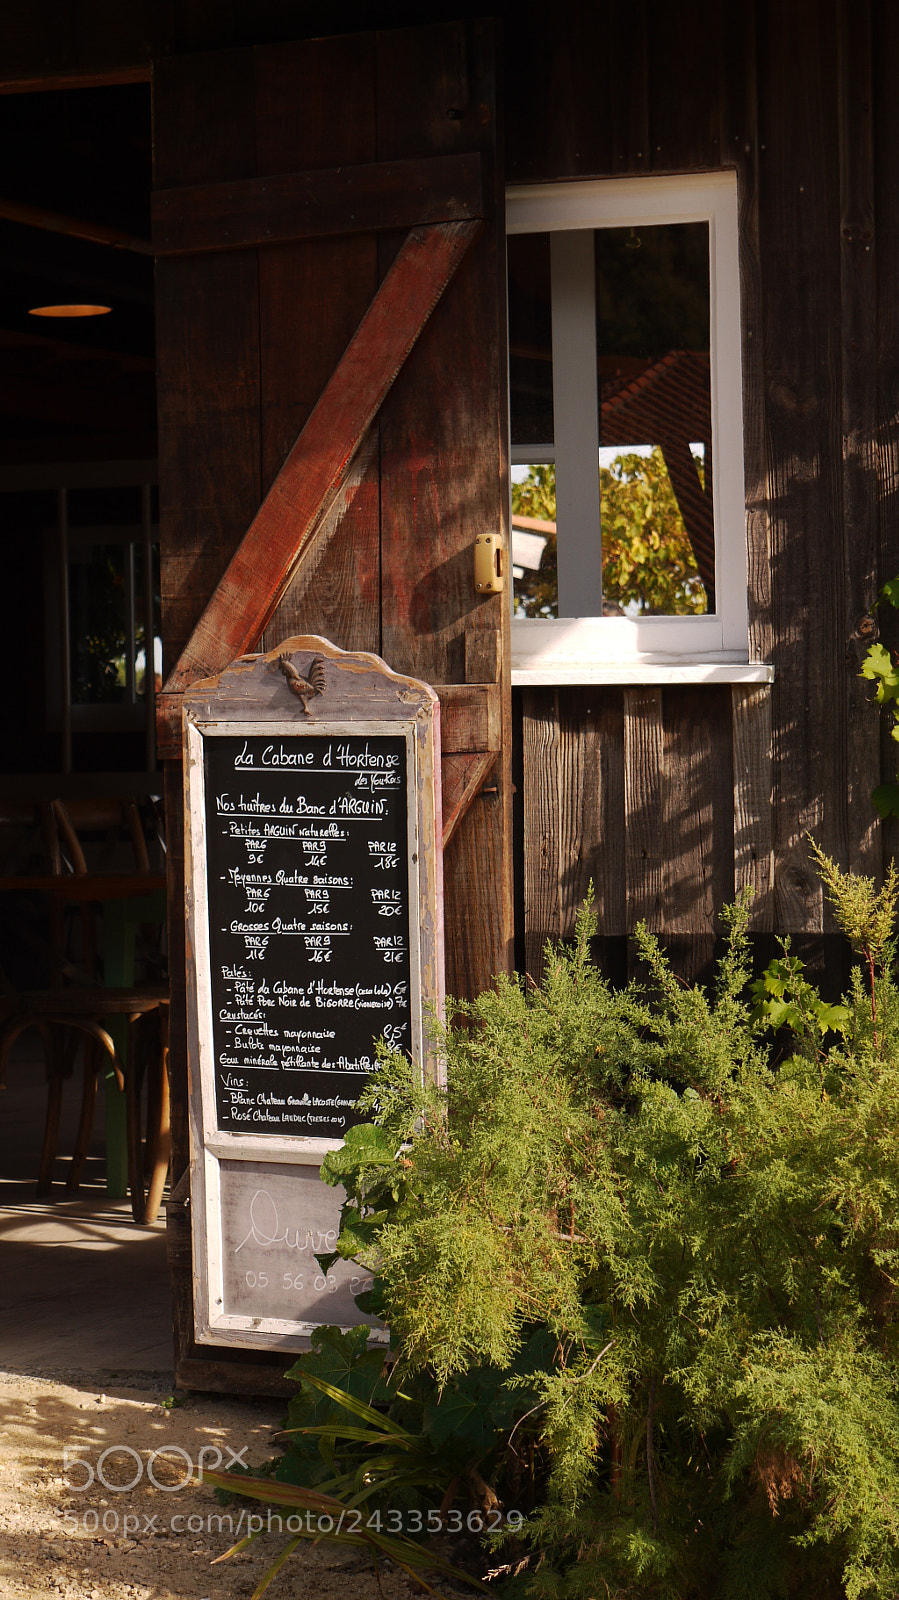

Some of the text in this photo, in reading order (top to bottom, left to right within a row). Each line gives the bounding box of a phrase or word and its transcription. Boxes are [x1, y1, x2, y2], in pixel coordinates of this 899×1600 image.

[234, 741, 400, 768] La Cabane d'Hortense
[216, 793, 235, 811] Nos
[279, 796, 293, 813] du
[296, 796, 326, 815] Banc
[229, 821, 261, 837] Petites
[247, 855, 264, 864] 9€
[244, 902, 265, 913] 10€
[307, 903, 330, 914] 15€
[378, 905, 402, 917] 20€
[307, 950, 333, 962] 16€
[273, 980, 305, 995] Cabane
[300, 996, 311, 1007] de
[283, 1029, 336, 1043] mayonnaise
[268, 1043, 321, 1057] mayonnaise
[220, 1073, 249, 1087] Vins:
[229, 1092, 255, 1106] Blanc
[230, 1106, 251, 1121] Rosé
[245, 1270, 269, 1288] 05
[282, 1272, 304, 1290] 56
[313, 1275, 338, 1293] 03
